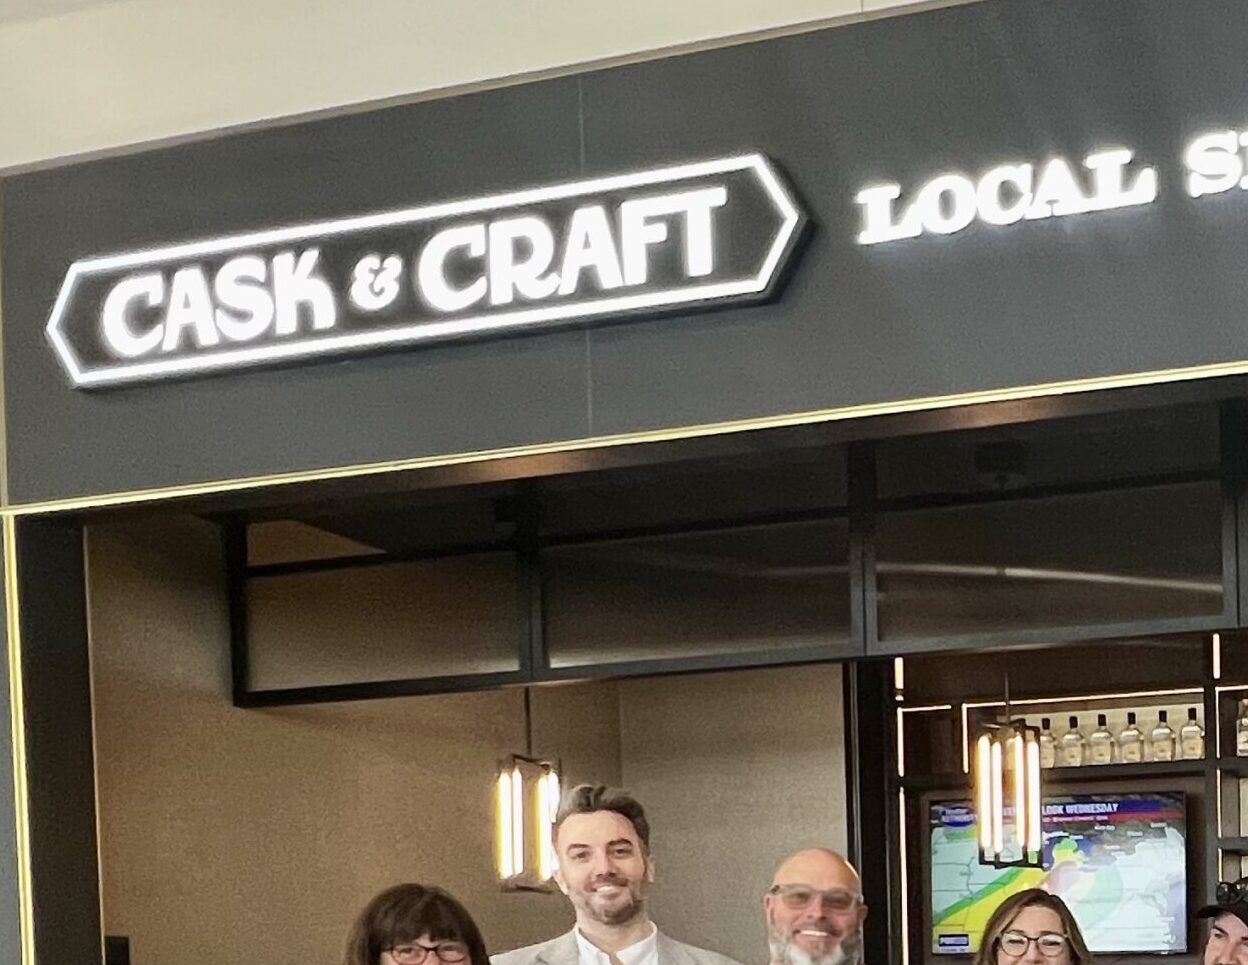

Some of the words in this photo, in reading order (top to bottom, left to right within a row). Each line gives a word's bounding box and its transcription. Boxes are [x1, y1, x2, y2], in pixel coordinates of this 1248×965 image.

[856, 149, 1157, 245] LOCAL
[100, 246, 338, 358] CASK
[349, 255, 405, 310] &
[418, 186, 730, 313] CRAFT
